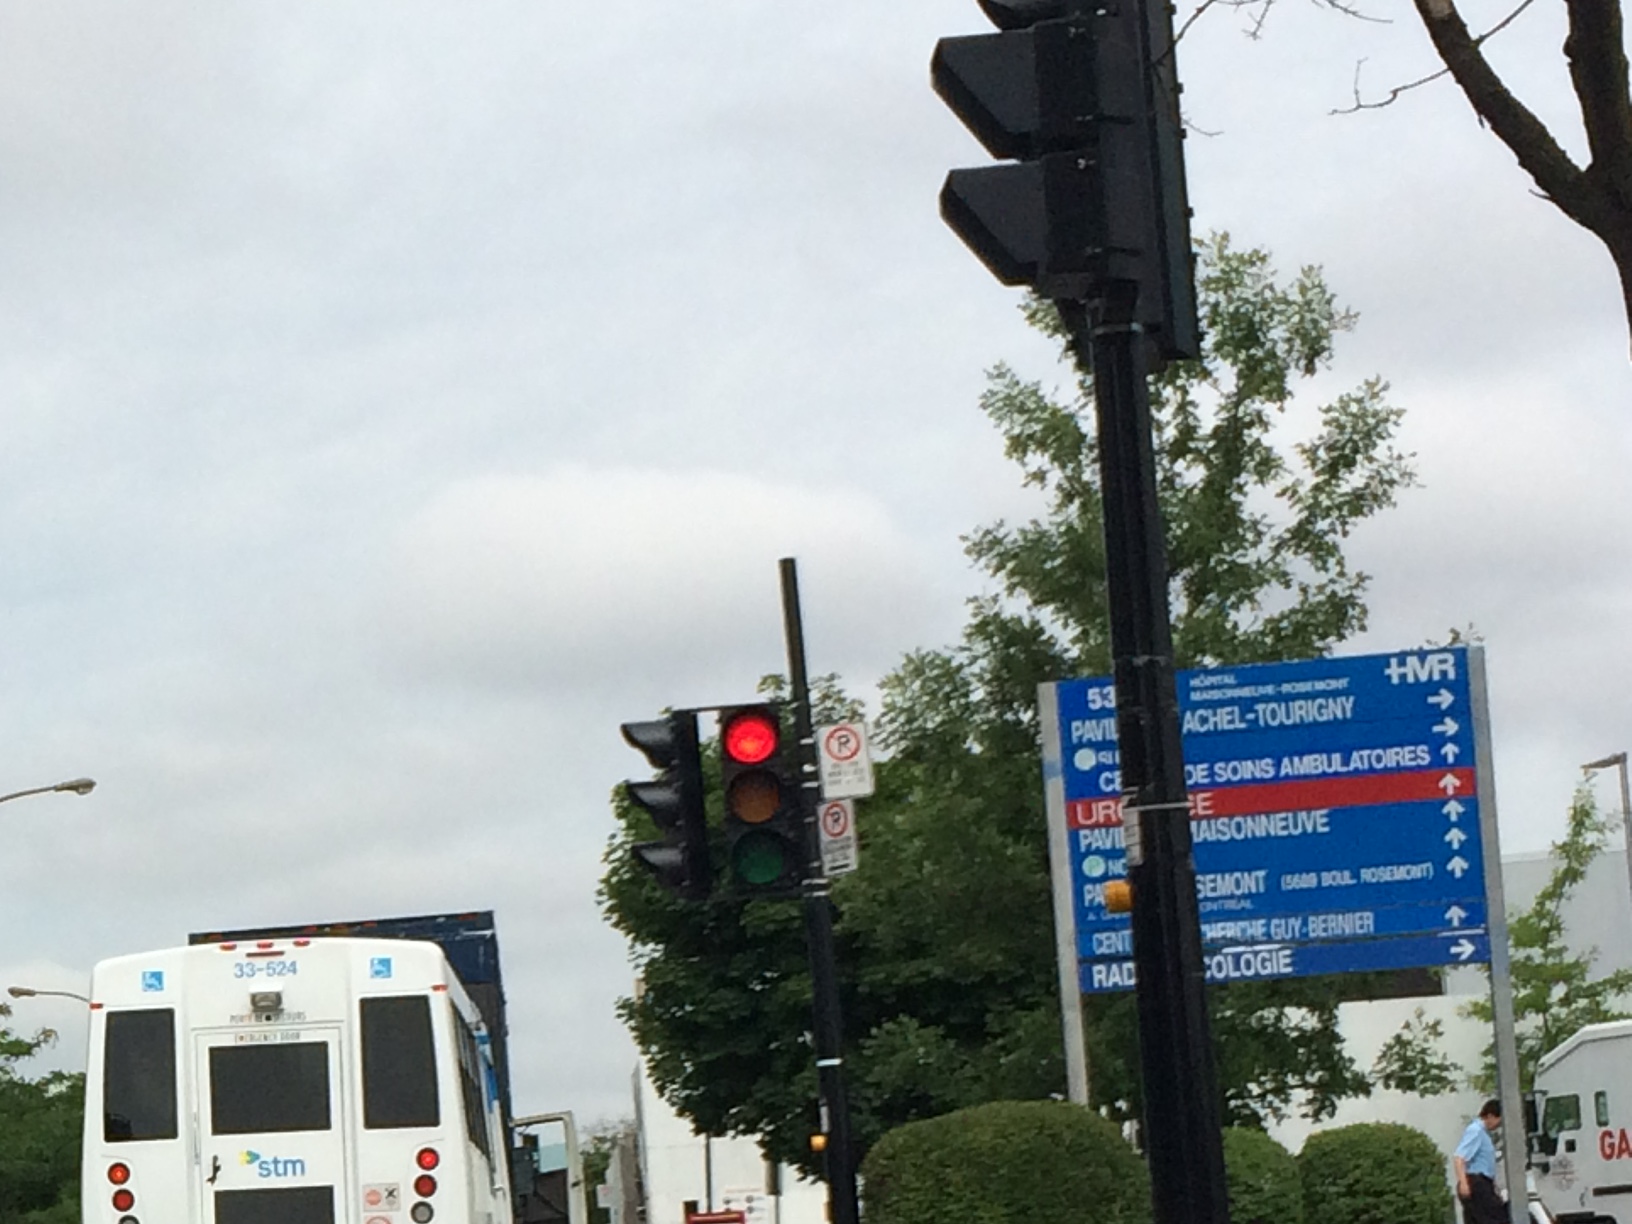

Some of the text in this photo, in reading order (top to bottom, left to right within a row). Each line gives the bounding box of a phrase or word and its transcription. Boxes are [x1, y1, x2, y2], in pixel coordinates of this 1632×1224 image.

[1087, 686, 1116, 711] 53
[1071, 695, 1355, 744] PAVIL ACHEL-TOURIGNY
[1214, 757, 1276, 783] SOINS
[1279, 744, 1431, 777] AMBULATOIRES
[1079, 827, 1126, 852] PAVIL
[1196, 869, 1268, 898] SEMONT
[1092, 930, 1133, 956] CENT
[234, 960, 298, 979] 33-524
[258, 1156, 306, 1179] stm
